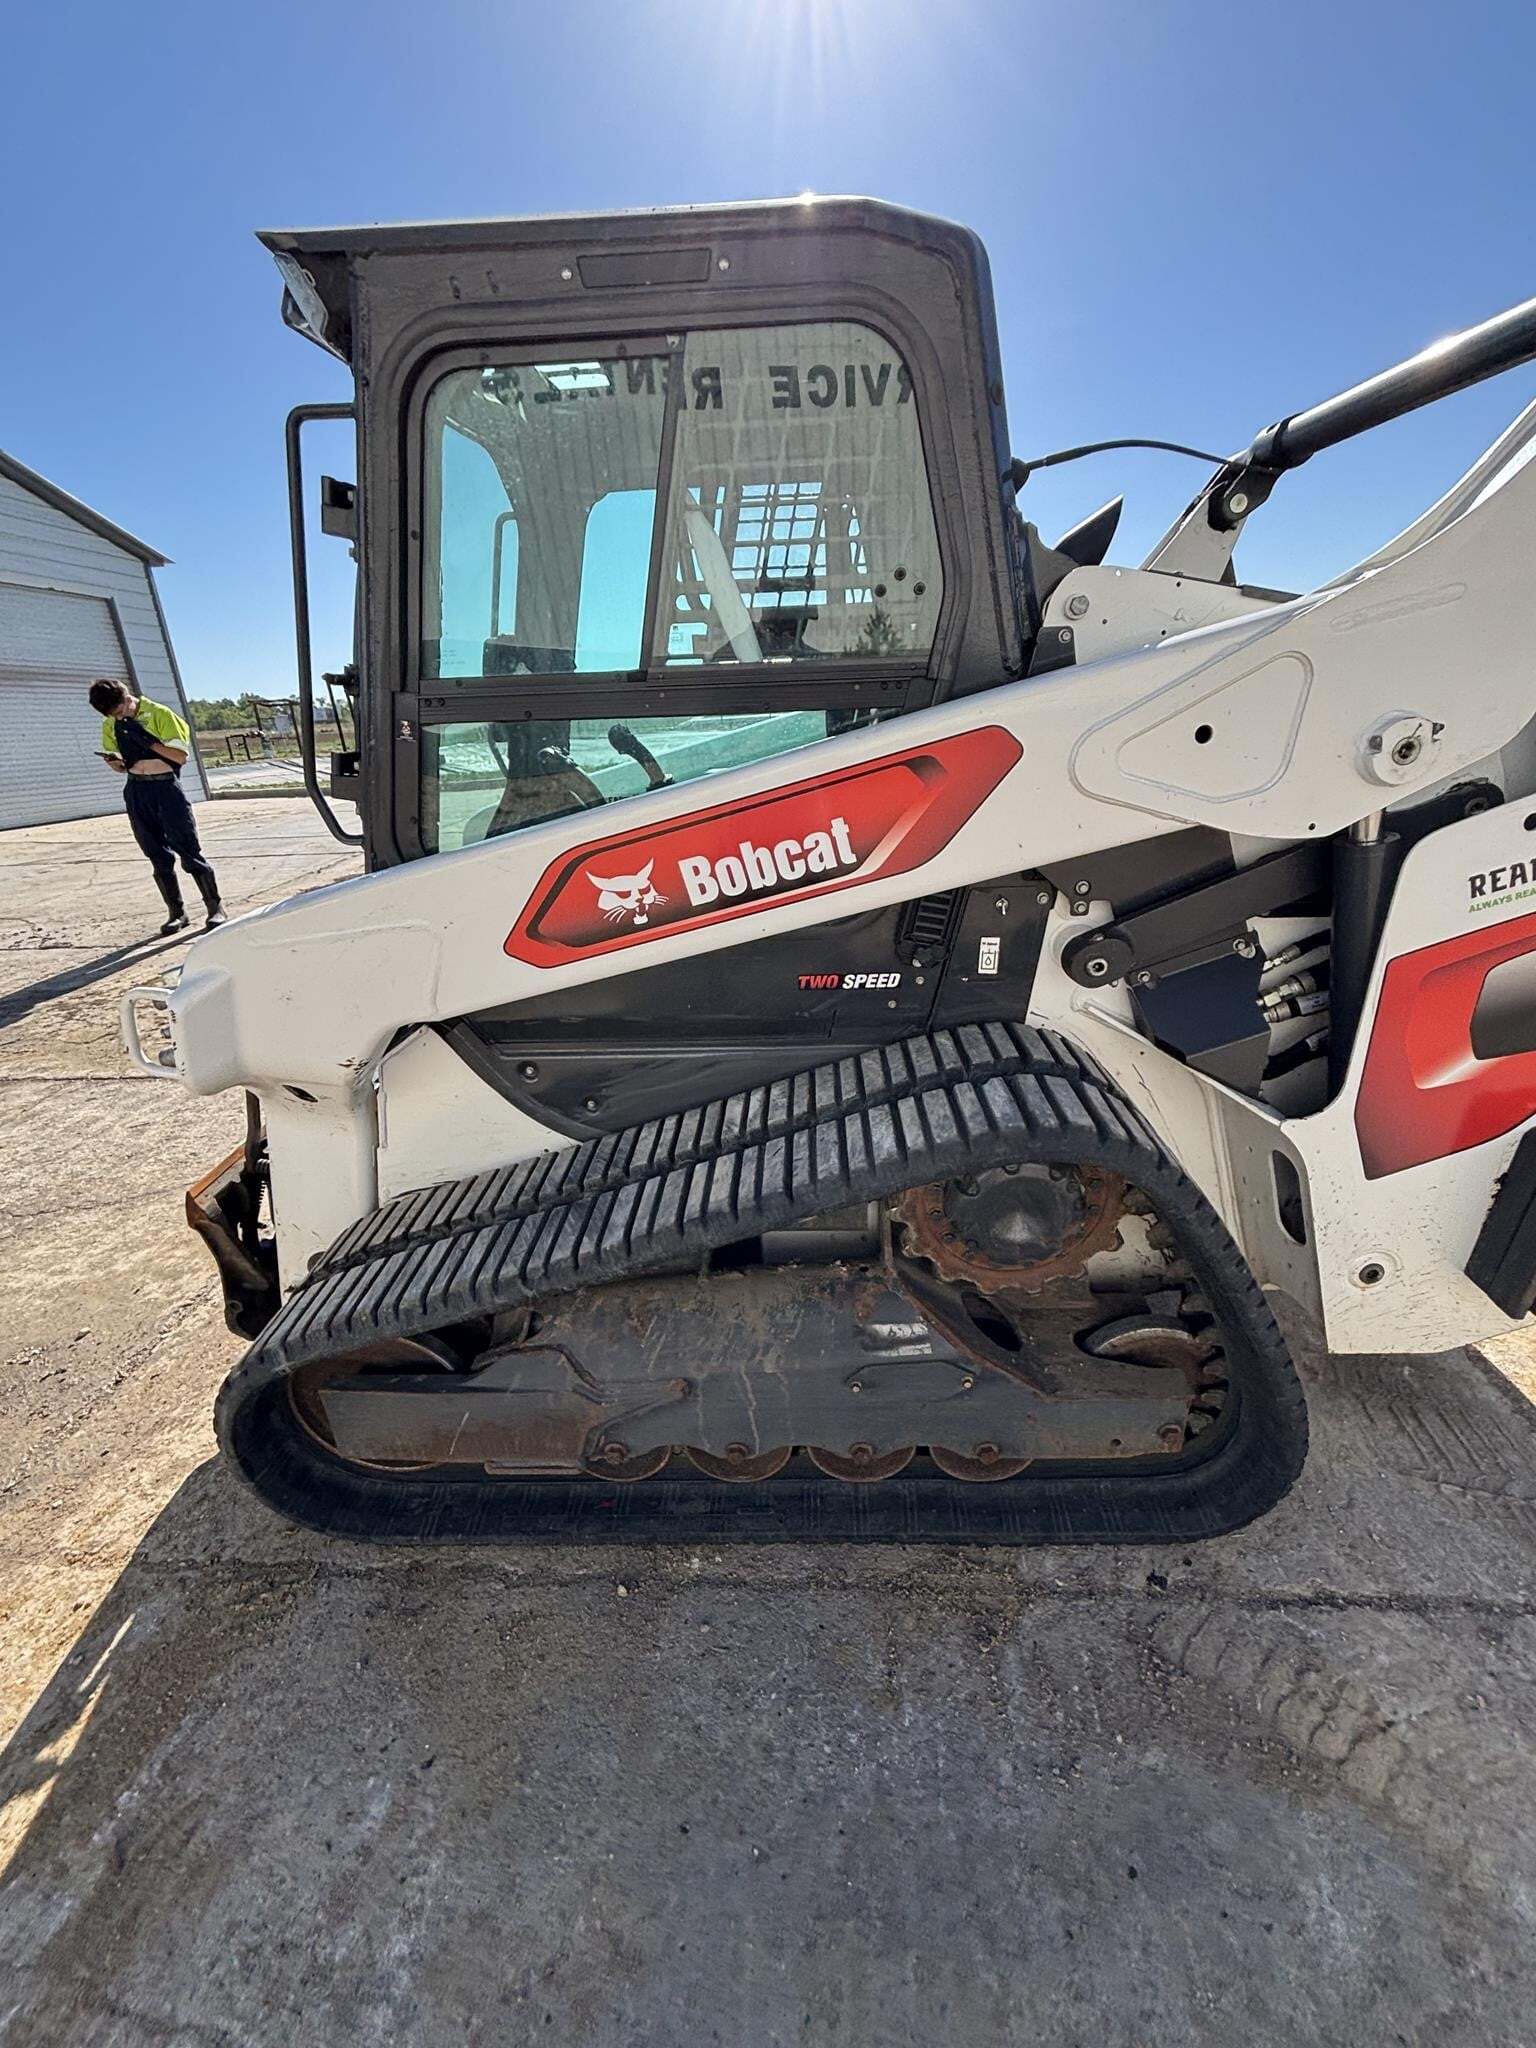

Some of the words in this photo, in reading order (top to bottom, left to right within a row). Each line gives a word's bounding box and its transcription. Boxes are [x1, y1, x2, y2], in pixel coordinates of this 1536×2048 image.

[678, 816, 857, 907] Bobcat
[1468, 894, 1513, 913] ALWAYS
[798, 974, 839, 990] TWO
[842, 973, 901, 990] SPEED
